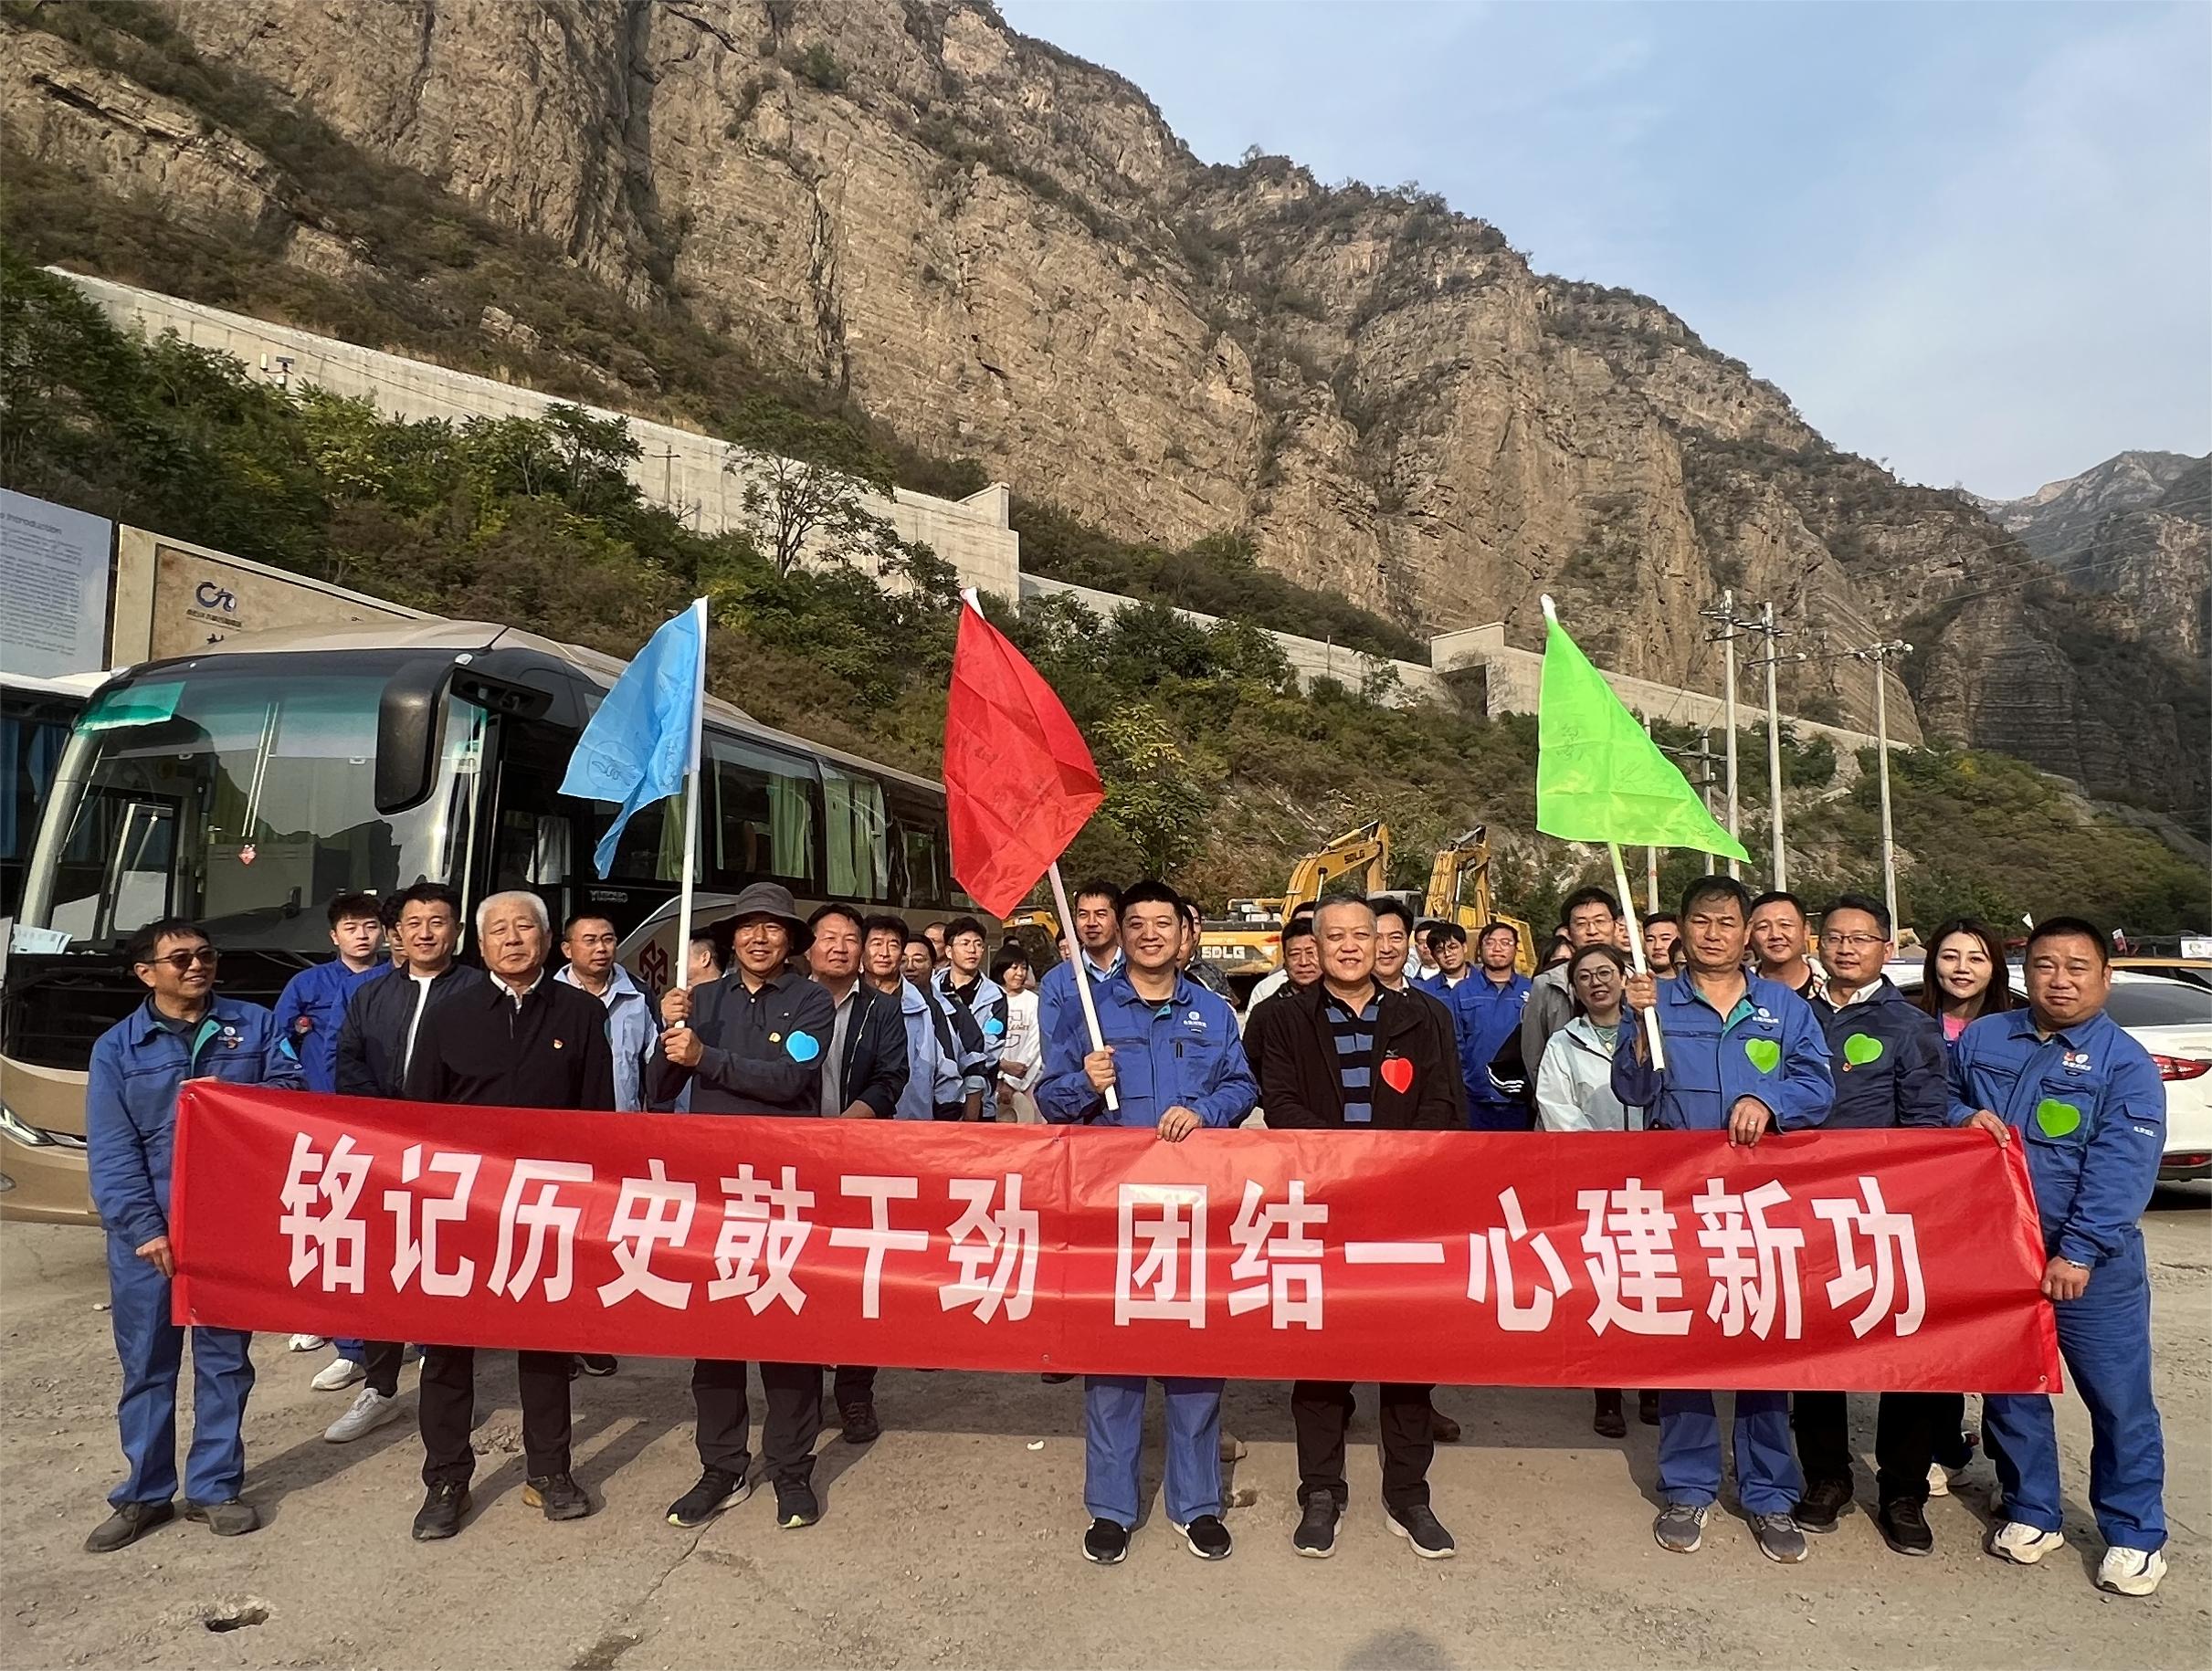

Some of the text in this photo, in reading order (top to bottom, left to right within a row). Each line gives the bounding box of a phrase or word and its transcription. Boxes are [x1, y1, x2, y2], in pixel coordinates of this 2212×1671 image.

[1201, 945, 1246, 960] SDLG
[279, 1131, 1927, 1341] 铭记历史鼓干劲 团结一心建新功
